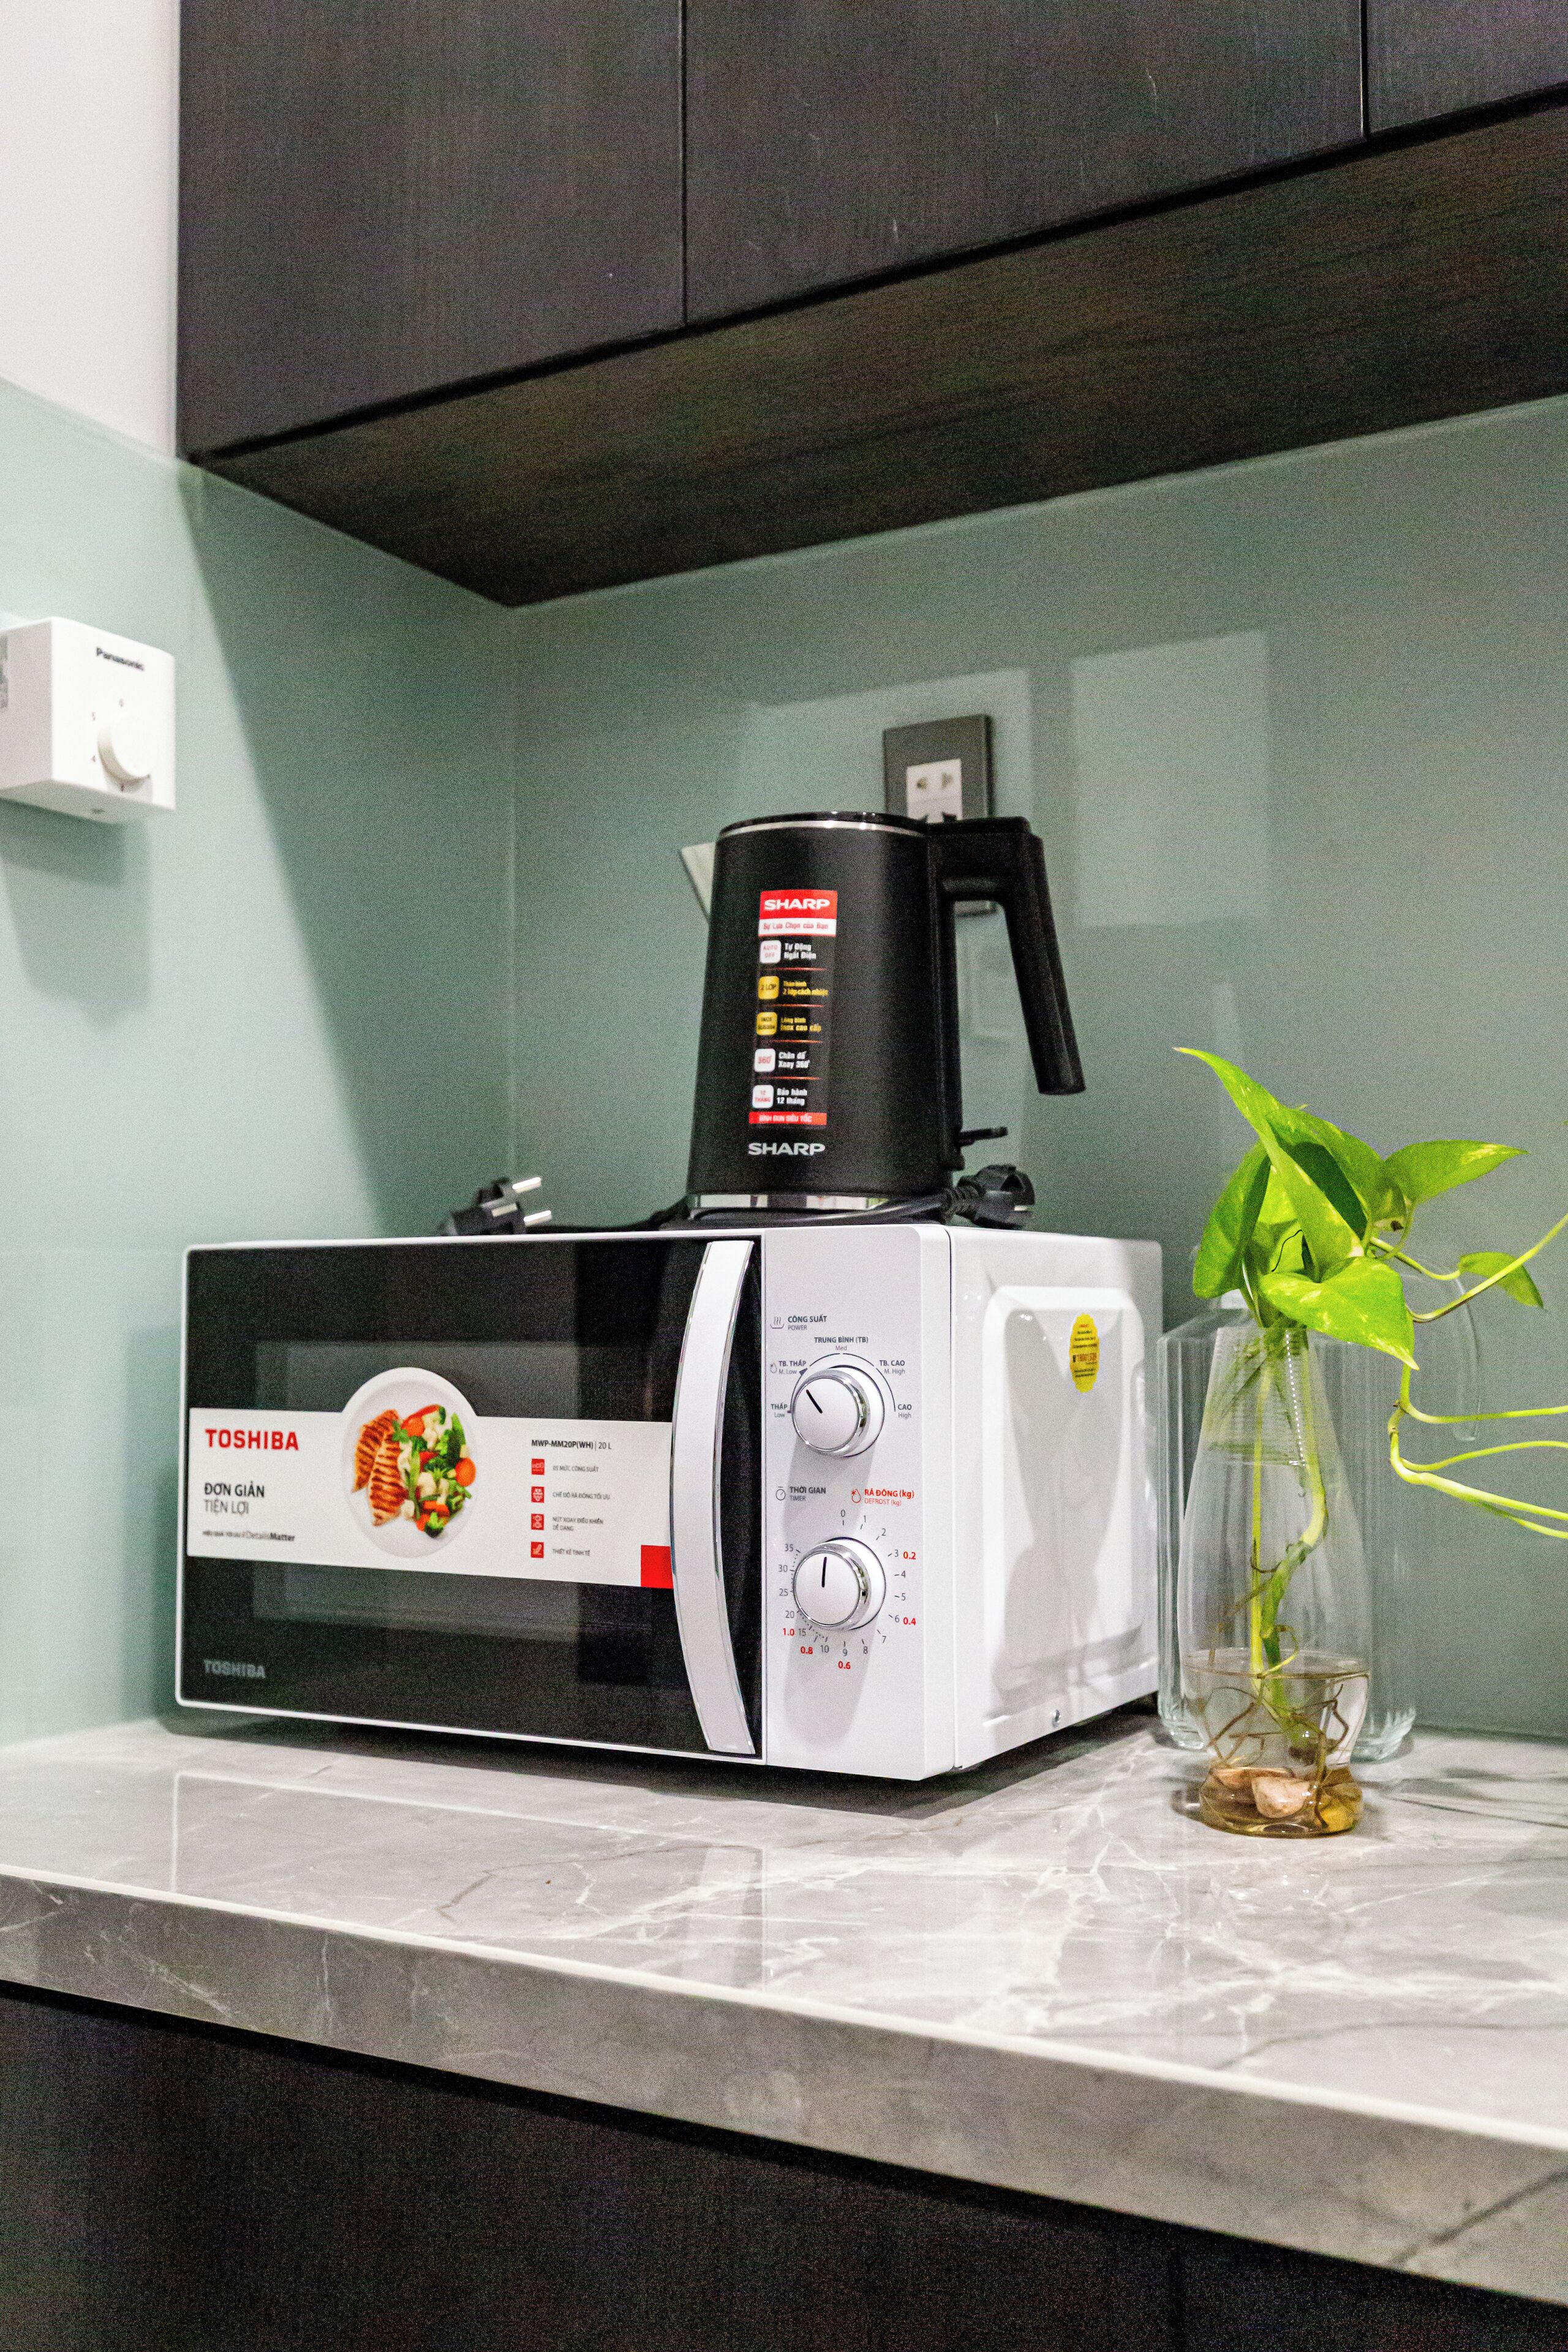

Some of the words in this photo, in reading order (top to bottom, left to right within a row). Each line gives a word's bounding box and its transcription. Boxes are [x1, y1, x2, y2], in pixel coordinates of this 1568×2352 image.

[764, 898, 831, 911] SHARP
[747, 1142, 826, 1156] SHARP
[788, 1315, 809, 1324] CÔNG
[809, 1313, 827, 1323] SUẤT
[205, 1428, 300, 1451] TOSHIBA
[531, 1439, 594, 1449] MWP-MM20P(WH)
[204, 1482, 232, 1496] ĐƠN
[234, 1480, 266, 1498] GIẢN
[875, 1488, 898, 1498] ĐÔNG
[899, 1490, 915, 1499] (kg)
[203, 1499, 228, 1516] TIỆN
[231, 1500, 249, 1517] LỢI
[840, 1509, 846, 1518] 0
[903, 1551, 916, 1560] 0.2
[778, 1564, 788, 1573] 30
[900, 1570, 907, 1578] 4
[900, 1593, 907, 1601] 5
[894, 1615, 900, 1623] 6
[903, 1616, 917, 1626] 0.4
[798, 1628, 807, 1637] 15
[800, 1646, 814, 1654] 0.8
[820, 1645, 830, 1653] 10
[842, 1648, 848, 1657] 9
[862, 1646, 869, 1654] 8
[203, 1658, 266, 1679] TOSHIBA
[838, 1660, 851, 1670] 0.6
